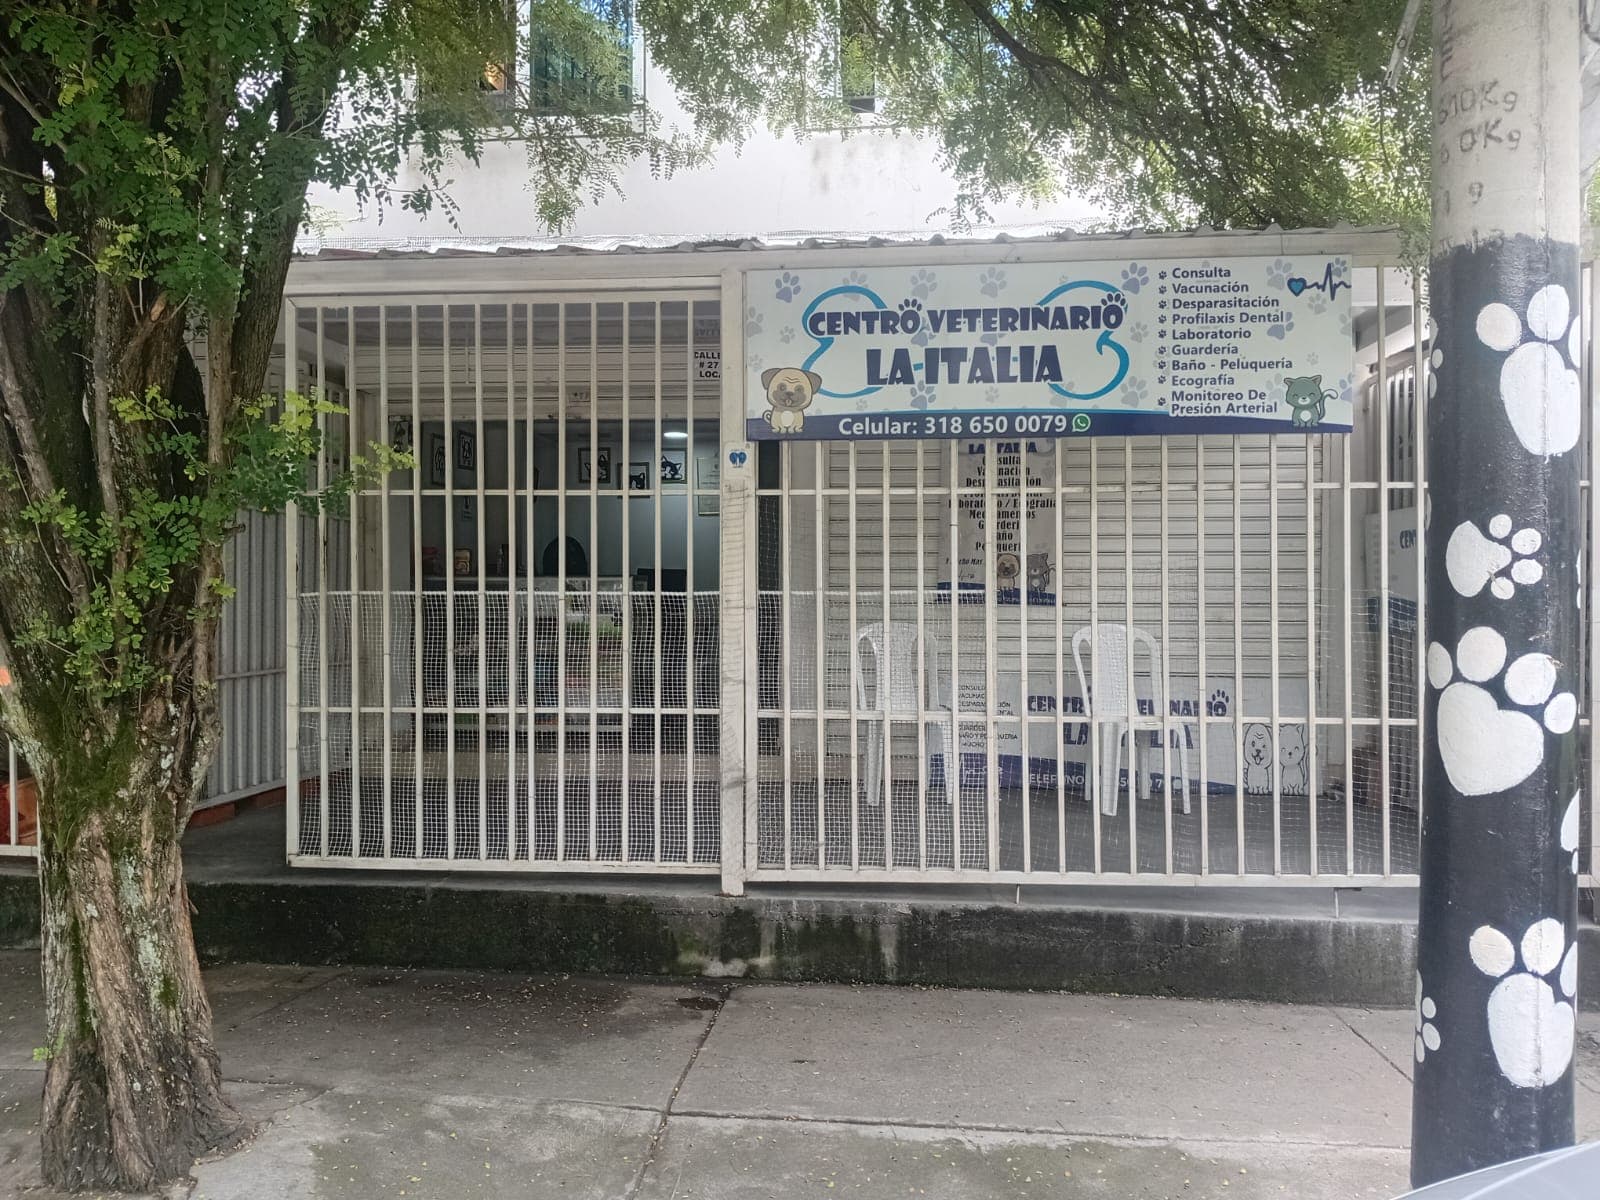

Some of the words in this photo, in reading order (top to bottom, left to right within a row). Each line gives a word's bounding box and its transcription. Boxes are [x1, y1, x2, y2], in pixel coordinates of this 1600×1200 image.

[1171, 266, 1232, 279] Consulta
[1171, 281, 1249, 294] Vacunación
[1172, 296, 1280, 311] Desparasitación
[808, 308, 921, 336] CENTRO
[927, 303, 1124, 334] VETERINARIO
[1172, 312, 1235, 325] Profilaxis
[1239, 310, 1284, 323] Dental
[1172, 327, 1252, 340] Laboratorio
[1171, 343, 1239, 355] Guardería
[866, 348, 915, 386] LA
[924, 345, 1063, 385] ITALIA
[1172, 359, 1206, 371] Baño
[1220, 357, 1293, 372] Peluquería
[699, 370, 721, 379] LOC
[1171, 373, 1235, 388] Ecografía
[1171, 390, 1244, 402] Monitoreo
[1248, 389, 1267, 401] De
[1171, 402, 1221, 415] Presión
[1226, 402, 1278, 414] Arterial
[838, 416, 918, 436] Celular:
[925, 416, 962, 434] 318
[969, 415, 1008, 433] 650
[1014, 414, 1067, 432] 0079
[982, 455, 1022, 466] Csulta
[977, 466, 1031, 477] Vanacin
[968, 509, 1037, 519] Medamenos
[991, 531, 1014, 541] año
[1027, 695, 1092, 714] CENTR
[1026, 772, 1085, 786] ELEFNO
